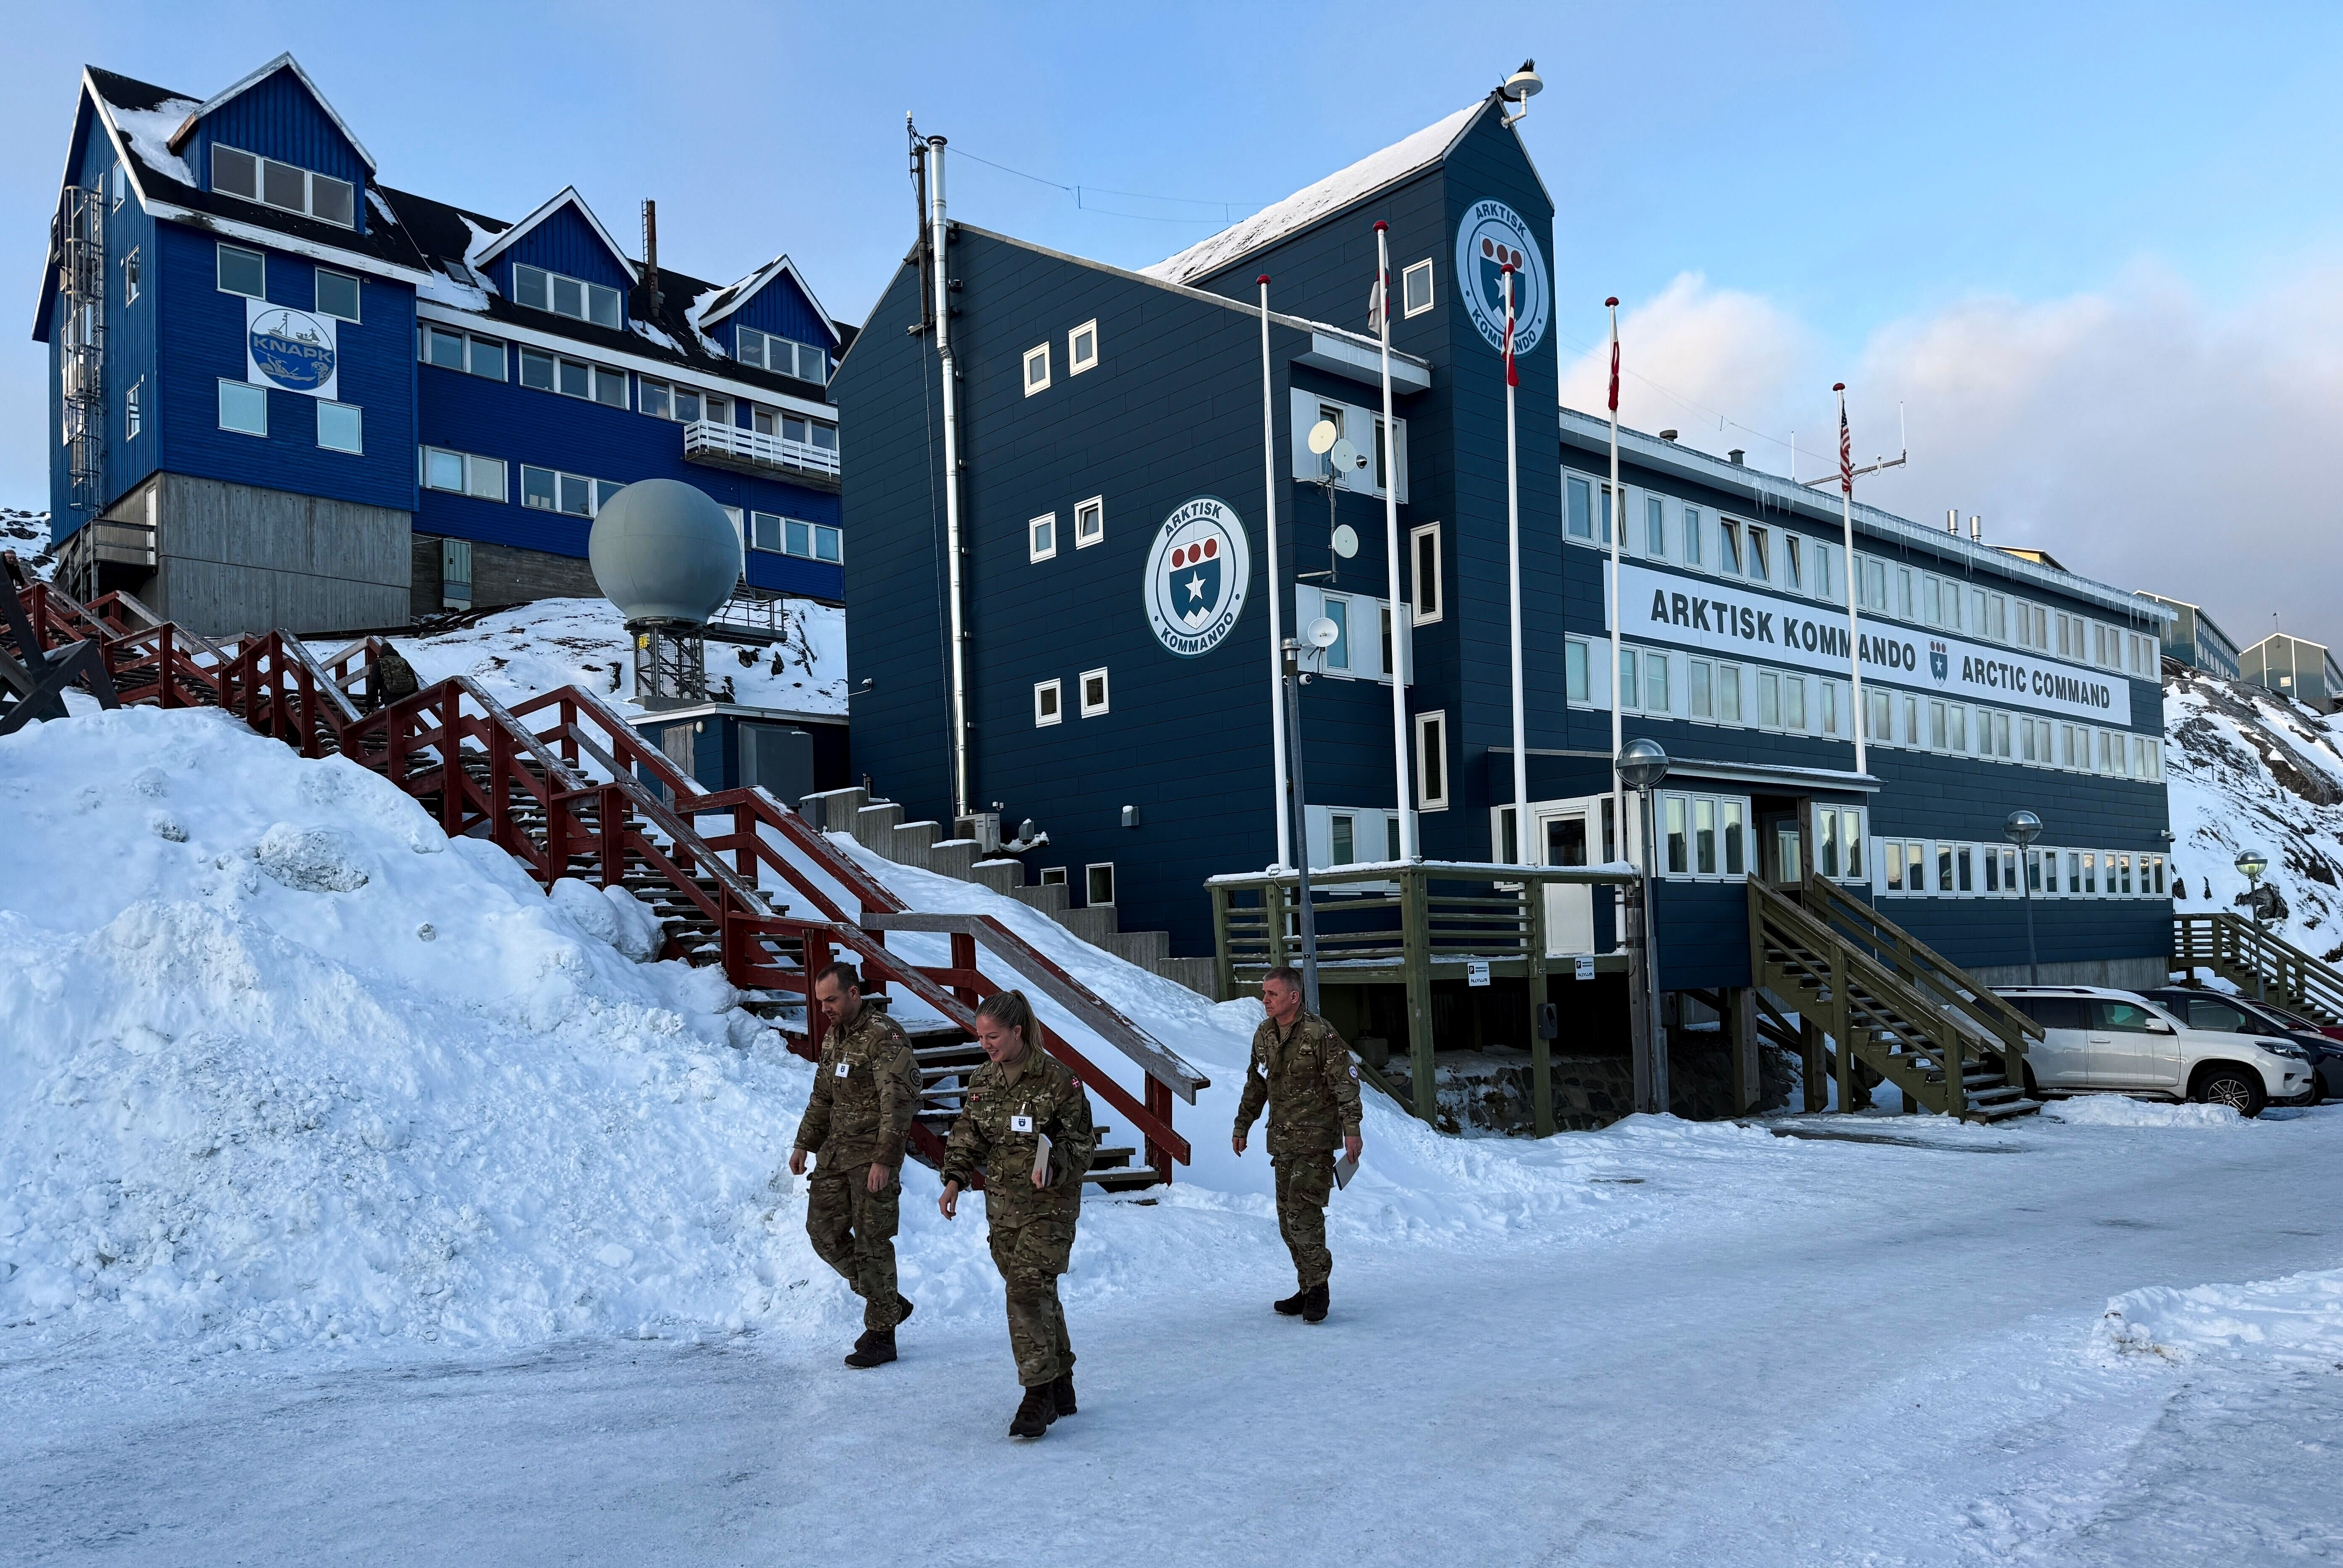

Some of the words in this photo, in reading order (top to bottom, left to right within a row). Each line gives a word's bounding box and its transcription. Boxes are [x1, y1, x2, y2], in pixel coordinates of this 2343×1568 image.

[1476, 203, 1526, 237] ARKTISK
[1472, 308, 1536, 352] KOMNDO
[254, 336, 332, 363] KNAPK
[1165, 502, 1222, 537] ARKTISK
[1161, 612, 1233, 652] KOMMANDO
[1651, 589, 1775, 643] ARKTISK
[1784, 617, 1915, 672] KOMMANDO
[1962, 656, 2027, 693] ARCTIC
[2032, 670, 2110, 709] COMMAND
